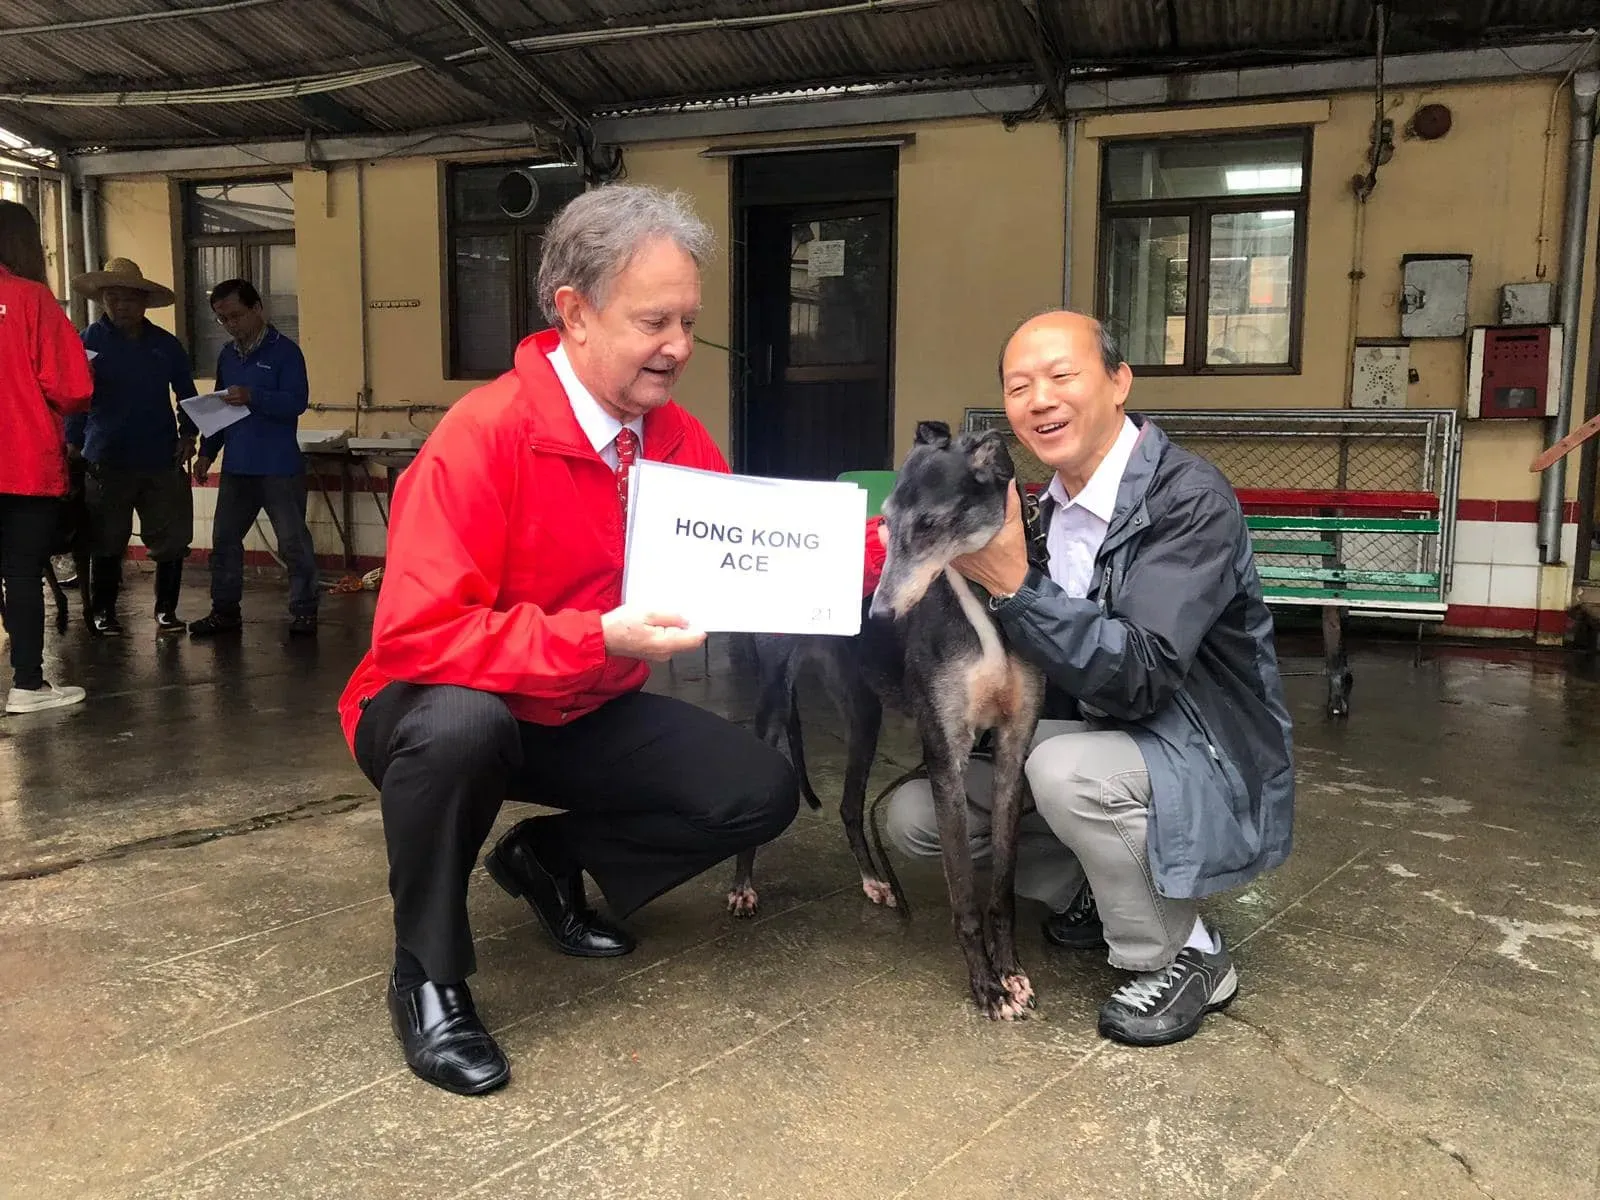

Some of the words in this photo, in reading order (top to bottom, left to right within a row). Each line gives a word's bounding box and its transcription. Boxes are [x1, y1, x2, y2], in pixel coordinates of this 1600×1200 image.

[675, 518, 743, 544] HONG
[751, 529, 820, 550] KONG
[720, 552, 769, 572] ACE
